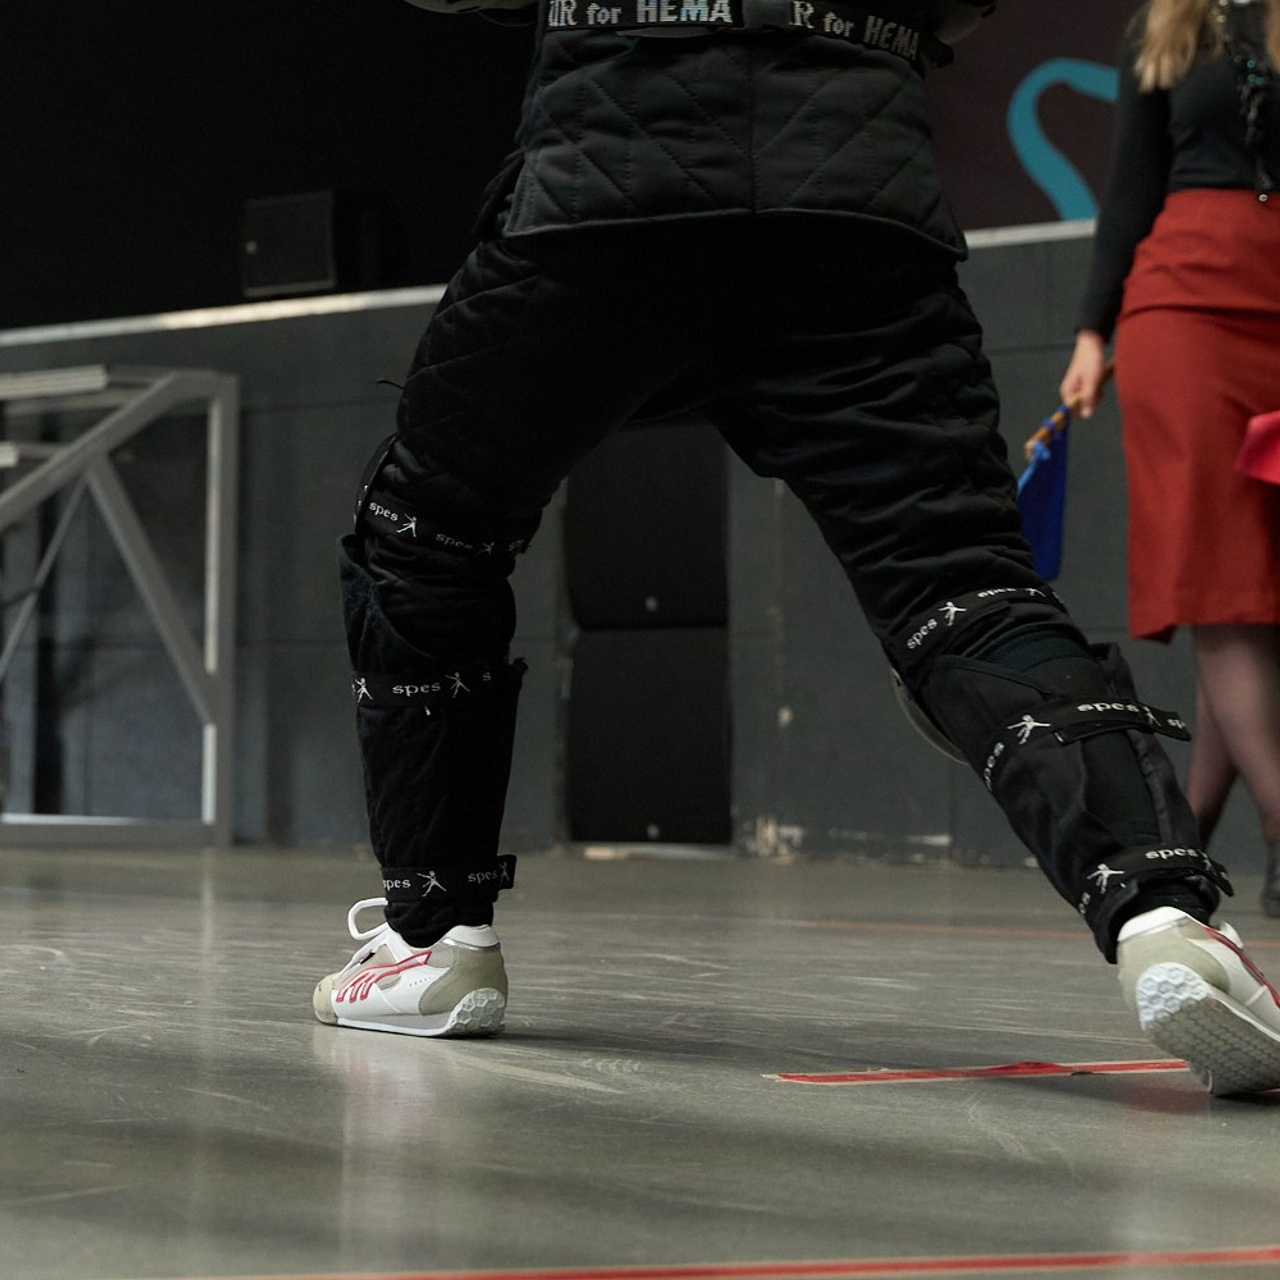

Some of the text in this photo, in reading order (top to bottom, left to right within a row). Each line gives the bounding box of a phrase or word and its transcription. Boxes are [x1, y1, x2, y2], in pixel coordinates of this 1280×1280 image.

[586, 2, 622, 25] for
[823, 11, 855, 37] for
[863, 14, 919, 61] HEMA
[368, 501, 399, 522] spes
[906, 618, 938, 649] spes
[391, 682, 442, 697] spes
[1145, 847, 1200, 860] spes
[467, 870, 498, 885] spes
